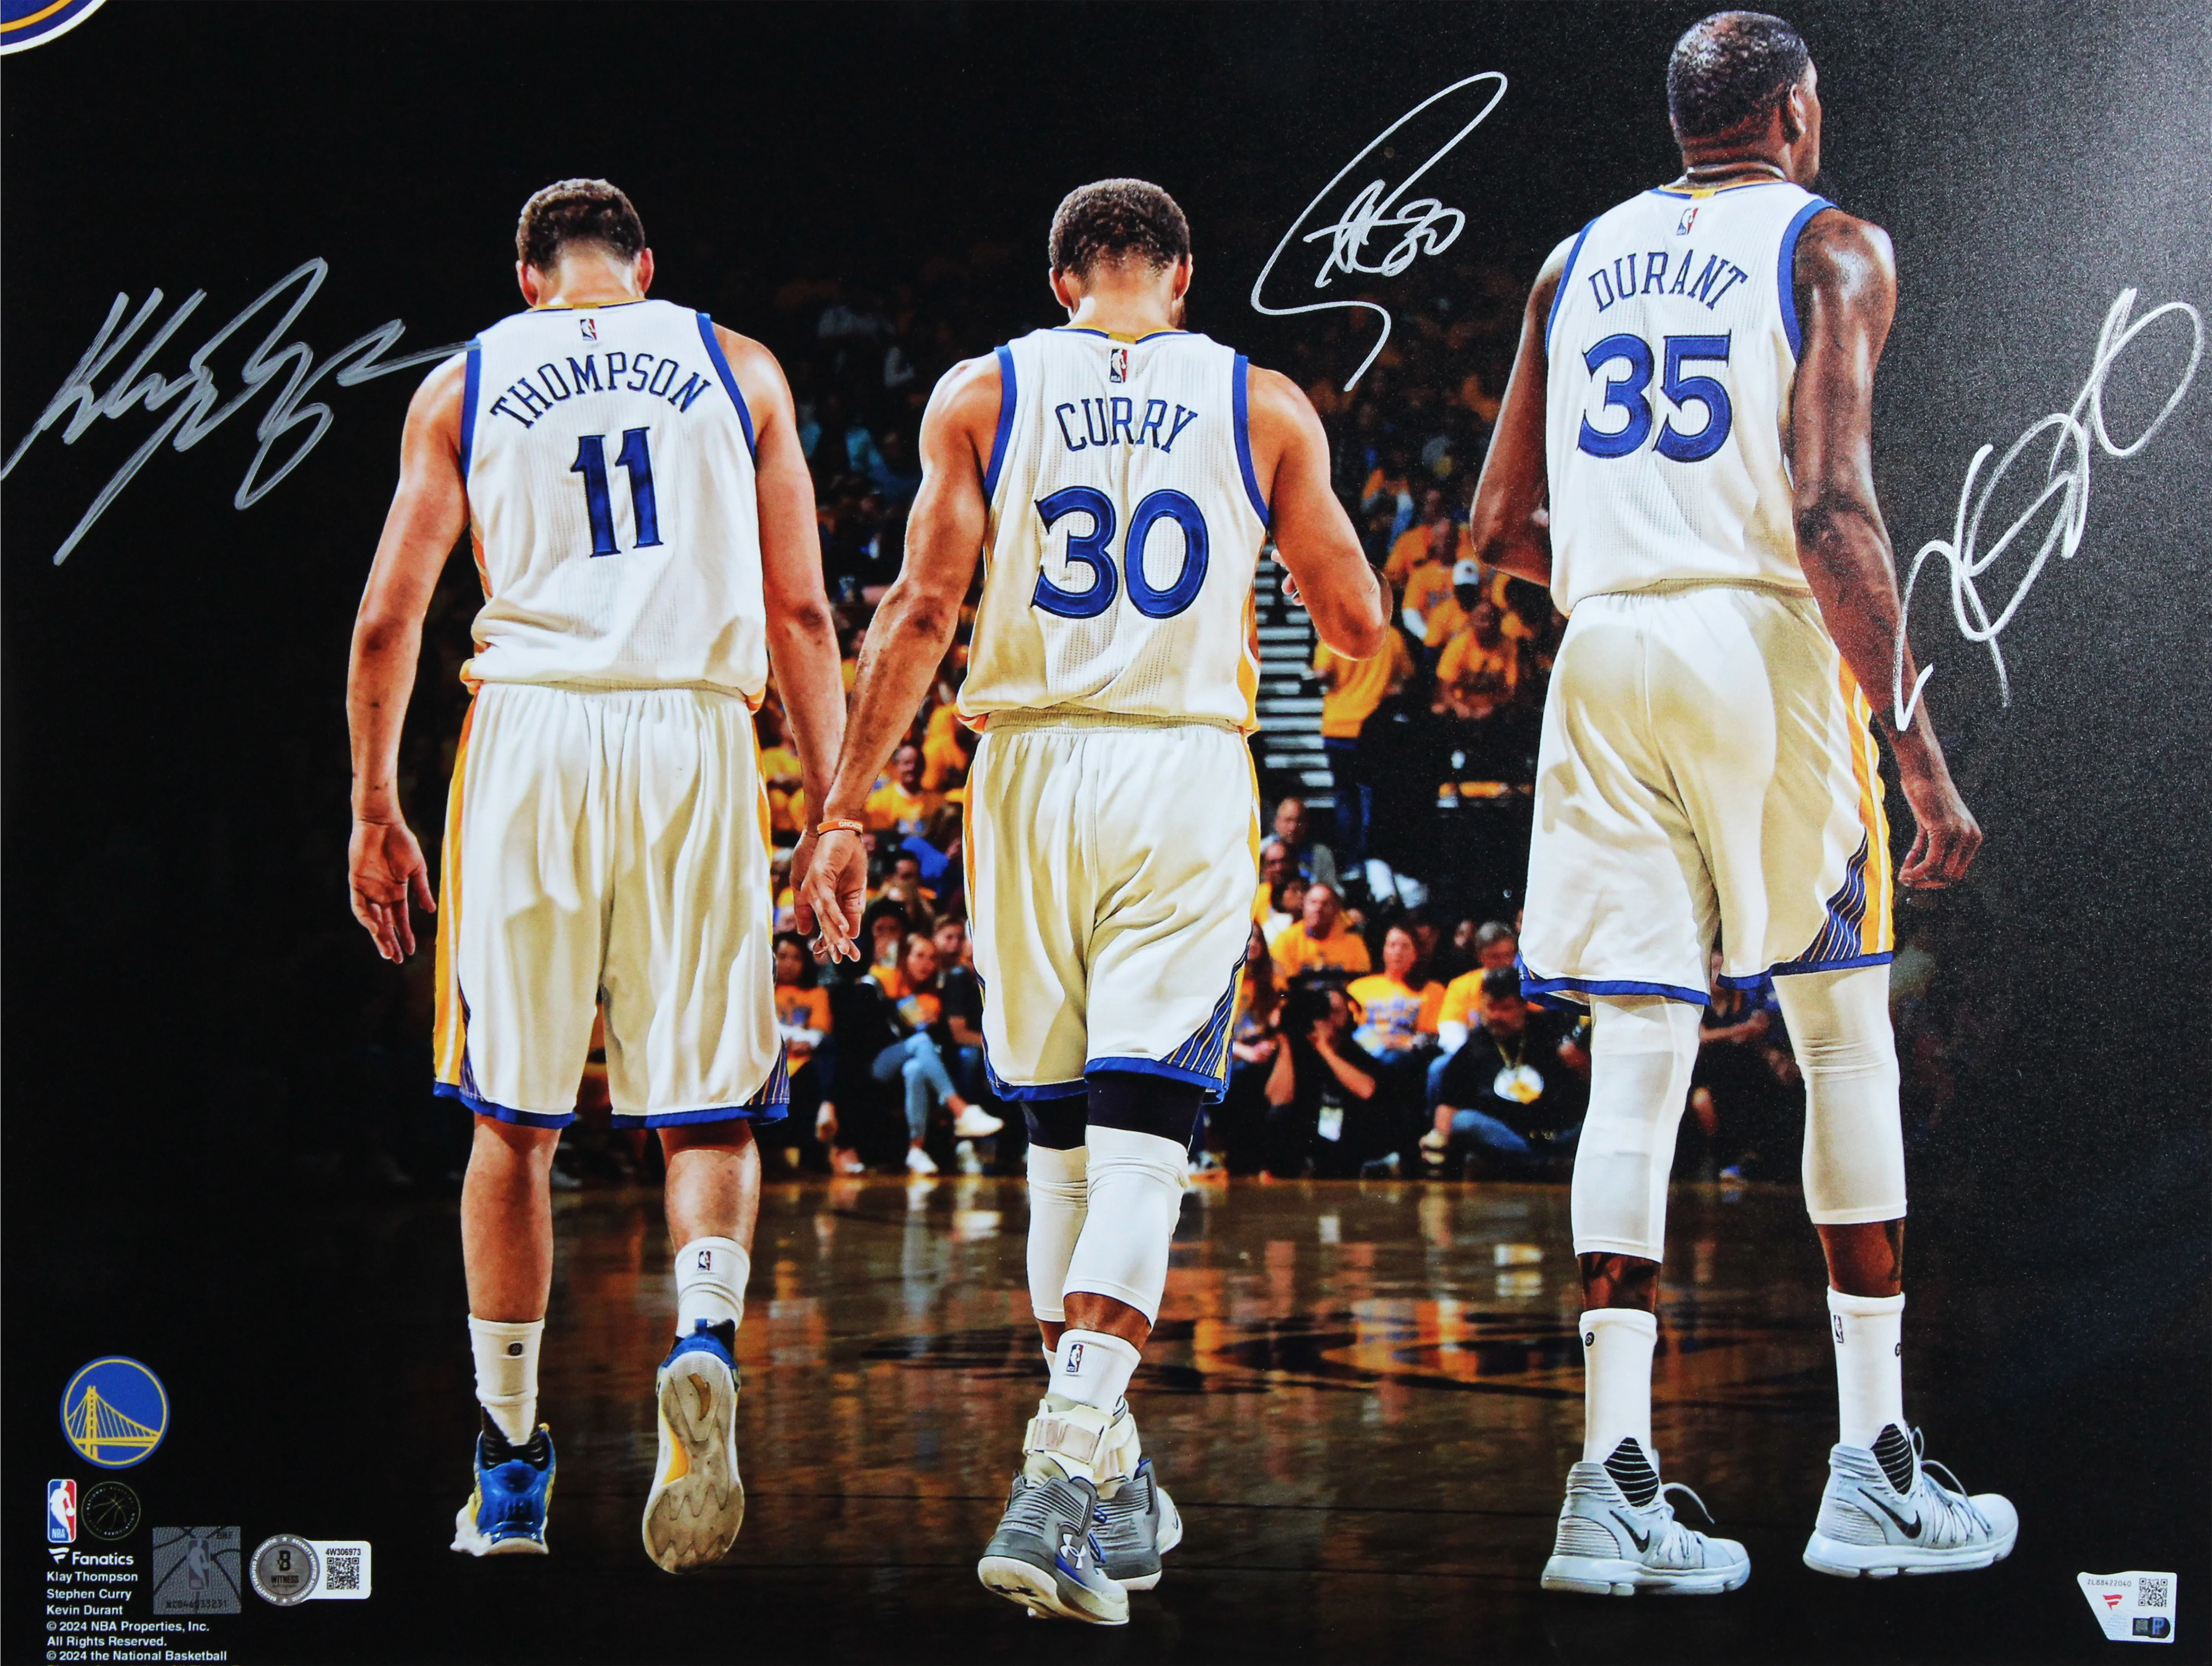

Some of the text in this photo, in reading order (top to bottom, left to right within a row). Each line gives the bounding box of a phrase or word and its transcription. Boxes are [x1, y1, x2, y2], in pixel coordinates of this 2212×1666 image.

[1588, 249, 1748, 313] DURANT
[490, 352, 711, 429] THOMPSON
[1576, 329, 1732, 463] 35
[1055, 397, 1197, 454] CURRY
[571, 427, 664, 558] 11
[1030, 486, 1209, 619] 30
[52, 1528, 66, 1538] NBA
[72, 1551, 134, 1565] Fanatics
[254, 1538, 277, 1561] AUTHENTIC
[279, 1550, 291, 1571] B
[47, 1571, 138, 1584] Klay Thompson
[291, 1538, 317, 1602] BECKETT VERIFIED AUTHENTIC
[2087, 1579, 2132, 1587] ZL88422040
[46, 1588, 132, 1601] Stephen Curry
[46, 1605, 124, 1615] Kevin Durant
[46, 1621, 210, 1633] © 2024 NBA Properties, Inc.
[47, 1636, 167, 1648] All Rights Reserved.
[46, 1650, 227, 1660] © 2024 the National Basketball
